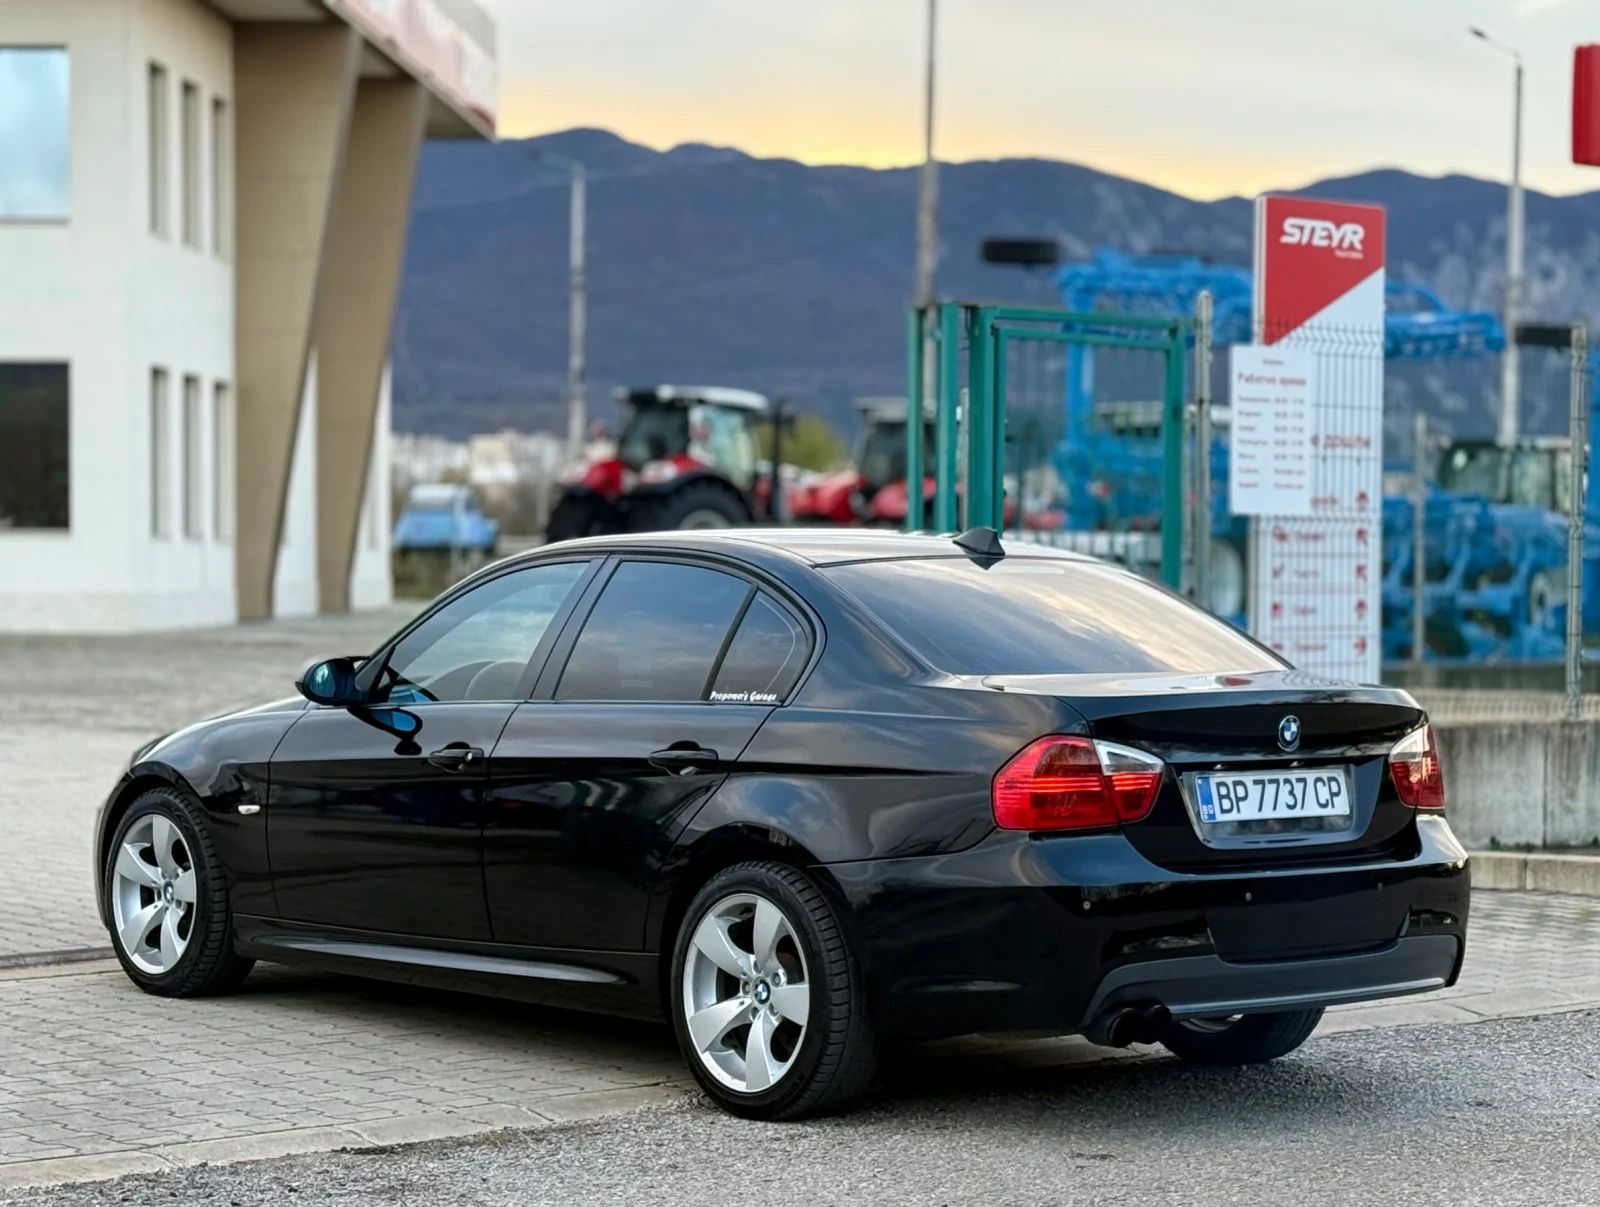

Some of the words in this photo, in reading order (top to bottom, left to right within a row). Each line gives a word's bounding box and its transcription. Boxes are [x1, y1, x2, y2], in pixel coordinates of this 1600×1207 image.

[1279, 216, 1365, 251] STEYR
[749, 690, 777, 702] Garage
[1215, 780, 1249, 815] BP
[1252, 777, 1308, 813] 7737
[1313, 776, 1342, 809] CP
